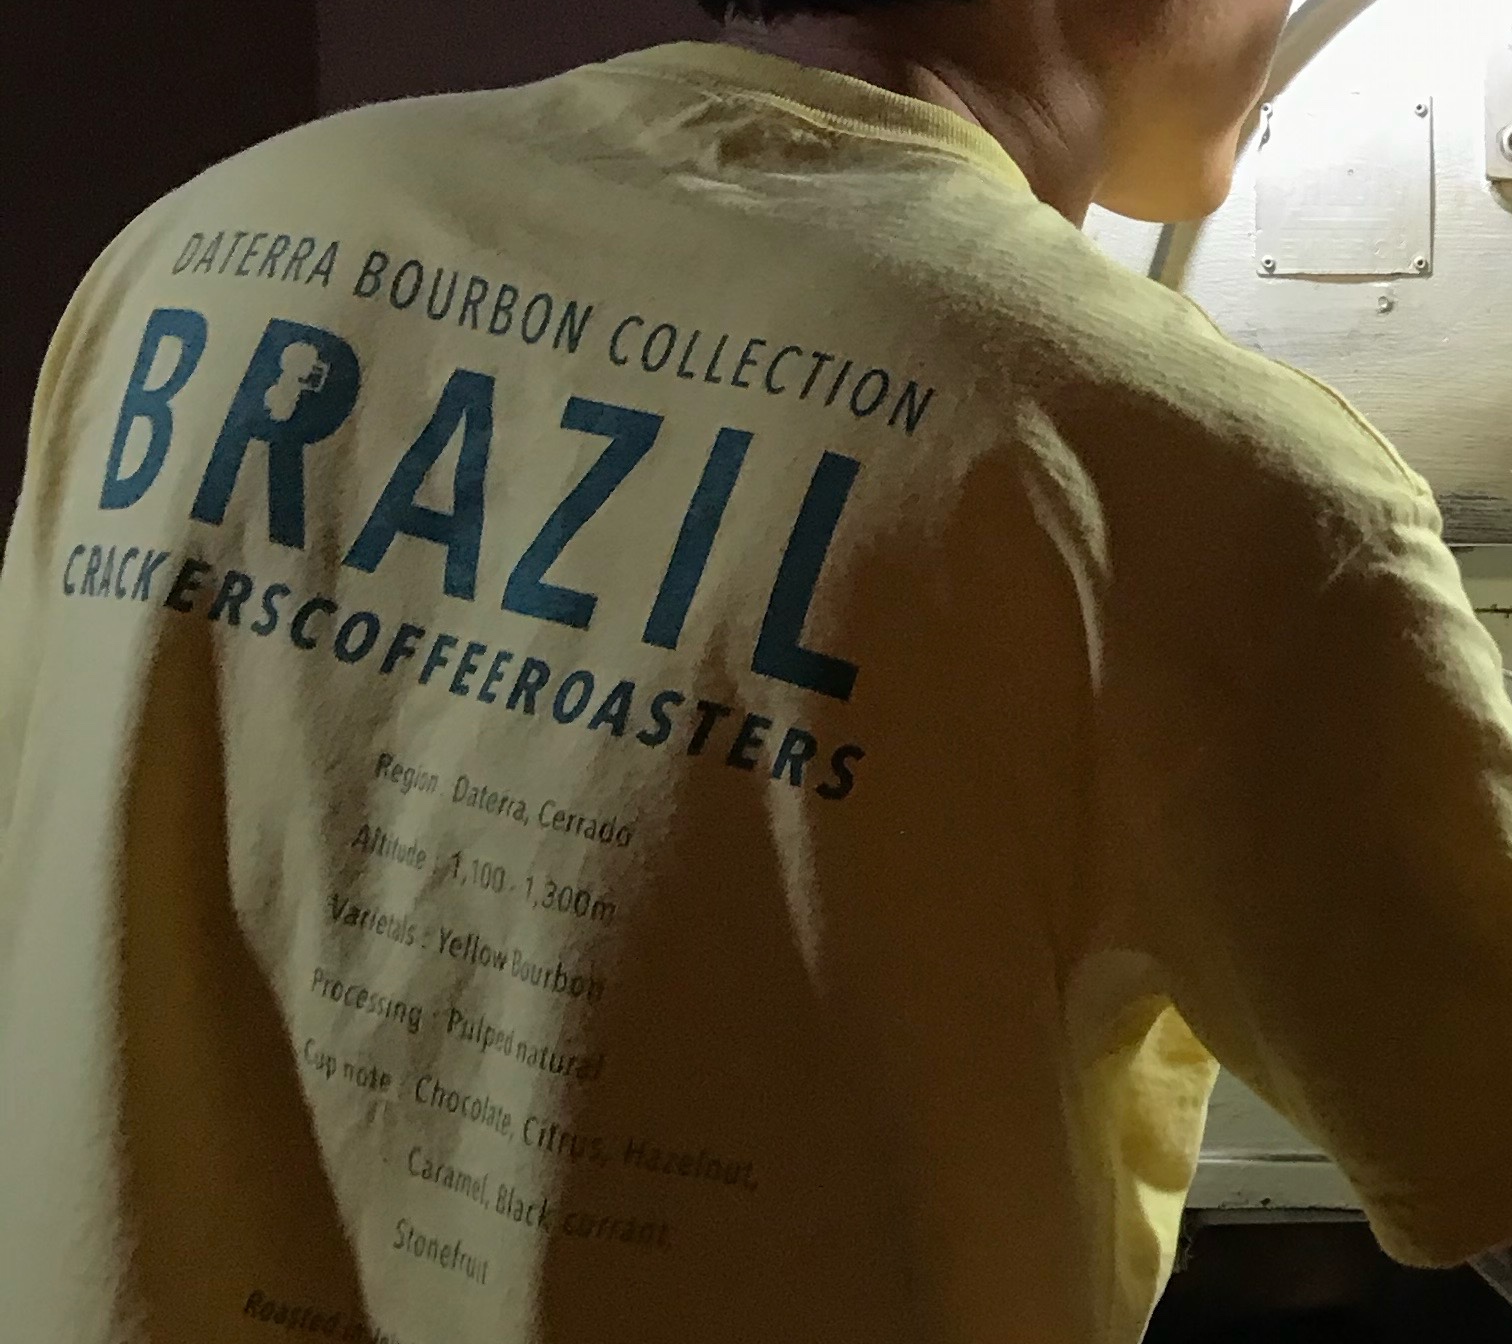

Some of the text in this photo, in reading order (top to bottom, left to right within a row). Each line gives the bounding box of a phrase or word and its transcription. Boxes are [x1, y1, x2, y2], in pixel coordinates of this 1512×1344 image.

[172, 231, 937, 437] DATERRA BOURBON COLLECTION
[98, 307, 862, 701] BRAZIL
[374, 752, 439, 794] Region
[538, 799, 636, 848] Cerrado
[351, 824, 428, 869] Altitude
[450, 849, 506, 893] 1,100
[525, 874, 616, 924] 1,300m
[328, 892, 418, 947] Varietals
[438, 925, 508, 971] Yellow
[512, 949, 606, 1002] Bourbon
[303, 1037, 337, 1080] Cup
[344, 1061, 393, 1092] note
[310, 966, 606, 1080] Processing Pulped natural
[392, 1215, 489, 1286] Stonefruit
[495, 1183, 550, 1230] Black
